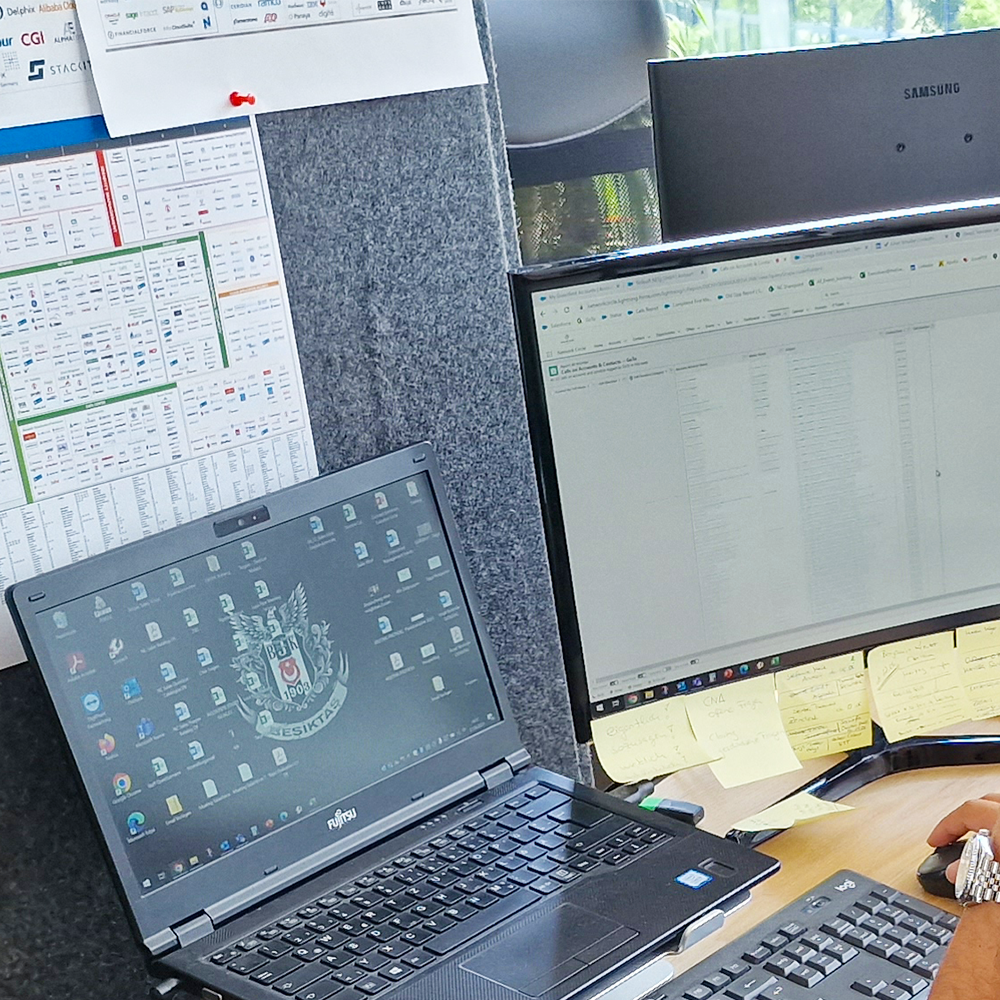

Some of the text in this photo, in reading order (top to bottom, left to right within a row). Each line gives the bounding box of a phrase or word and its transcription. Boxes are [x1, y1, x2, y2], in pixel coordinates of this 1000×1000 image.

[7, 6, 36, 17] Delphix
[39, 4, 62, 14] Alibaba
[21, 31, 45, 46] CGI
[903, 82, 961, 100] SAMSUNG
[283, 681, 312, 701] 1903
[327, 807, 357, 831] FUJITSU
[834, 877, 858, 893] logi
